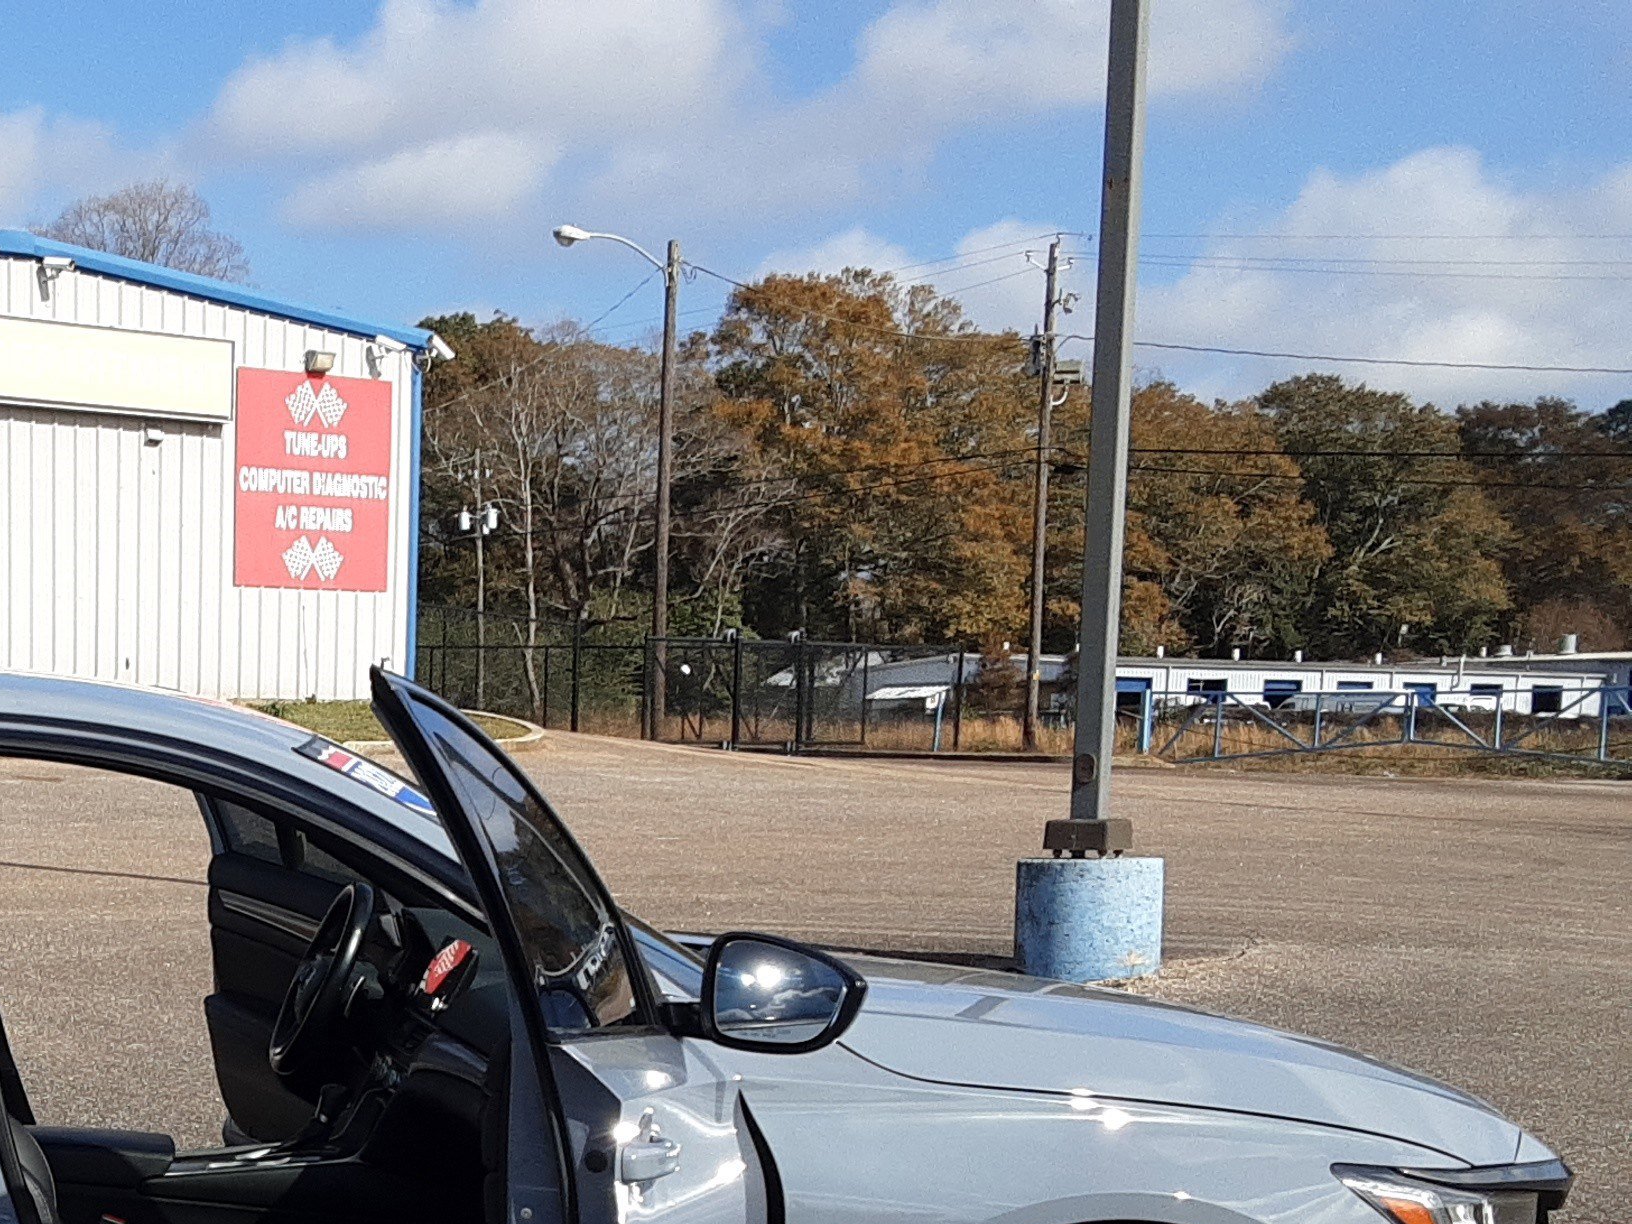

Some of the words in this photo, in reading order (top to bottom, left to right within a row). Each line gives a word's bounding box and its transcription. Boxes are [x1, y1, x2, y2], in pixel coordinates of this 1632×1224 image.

[284, 430, 347, 459] TUNE-UPS
[239, 466, 310, 495] COMPUTER
[312, 472, 387, 500] DIAGNOSTIC
[275, 505, 298, 530] A/C
[299, 506, 353, 533] REPAIRS
